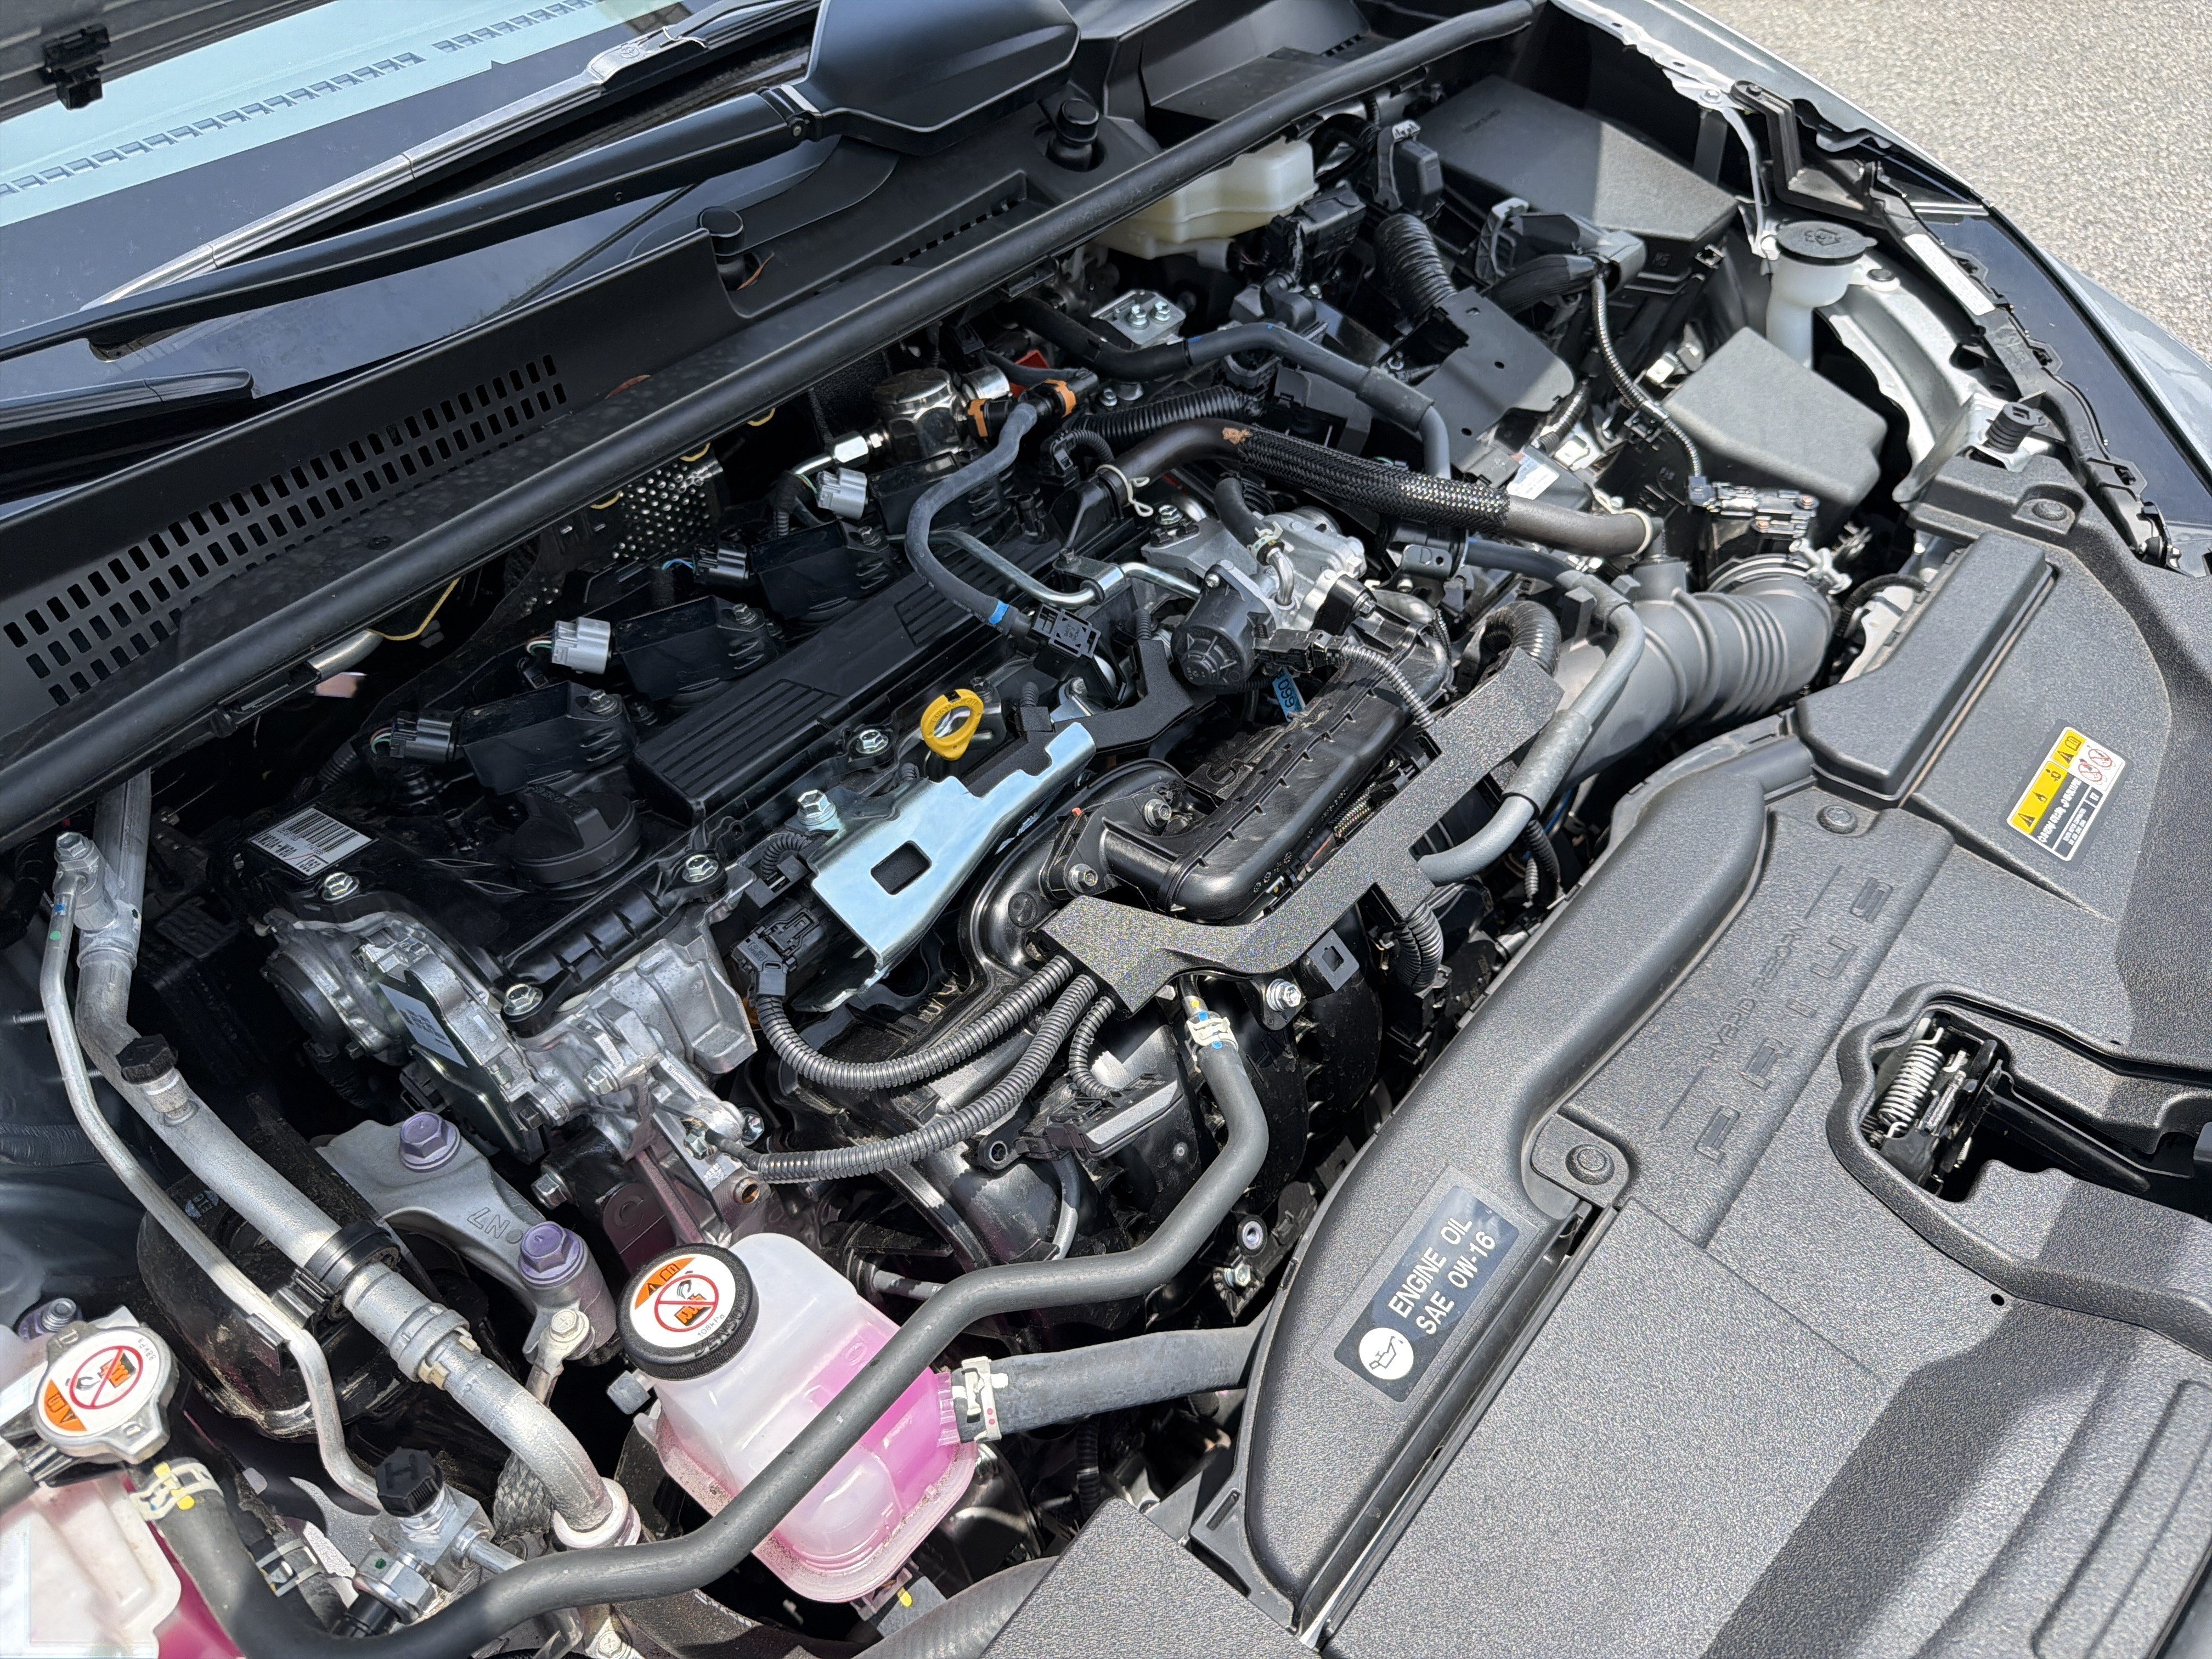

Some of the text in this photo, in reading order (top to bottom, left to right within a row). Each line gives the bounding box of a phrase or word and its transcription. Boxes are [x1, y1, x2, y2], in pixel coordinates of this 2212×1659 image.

[1695, 877, 1893, 1163] PRIUS
[1702, 921, 1805, 1063] HYBRID REBORN
[467, 1207, 511, 1239] N7
[1388, 1217, 1473, 1318] ENGINE OIL
[694, 1306, 744, 1357] DENSO
[697, 1314, 725, 1338] 108kPa
[1416, 1231, 1496, 1335] SAE 0W-16
